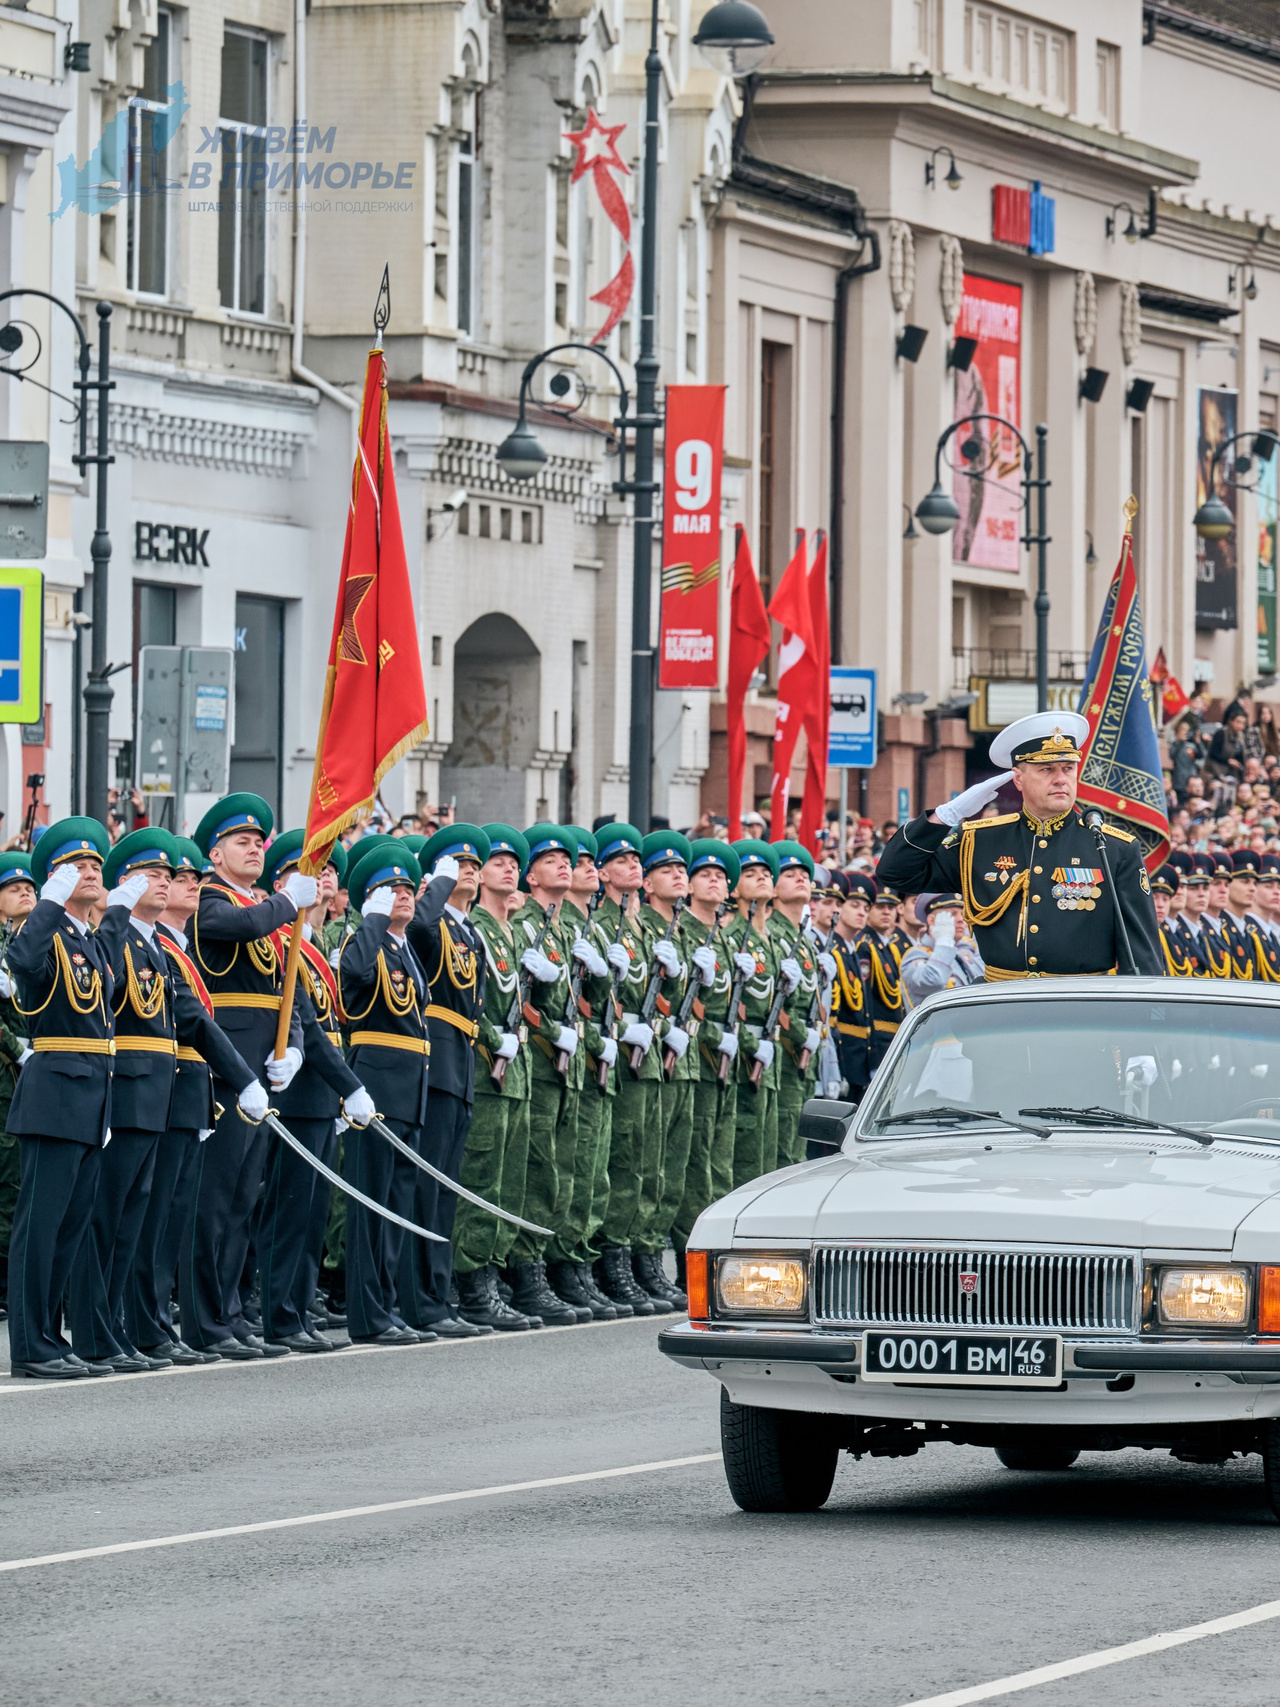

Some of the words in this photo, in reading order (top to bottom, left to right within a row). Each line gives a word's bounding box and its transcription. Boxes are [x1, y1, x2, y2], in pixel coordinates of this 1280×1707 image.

[674, 439, 713, 511] 9
[135, 521, 211, 567] BORK
[673, 514, 711, 534] МАЯ
[1095, 674, 1132, 757] СЛУЖИМ
[878, 1337, 958, 1371] 0001
[967, 1346, 1007, 1372] ВМ
[1014, 1339, 1046, 1364] 46
[1017, 1364, 1042, 1374] RUS
